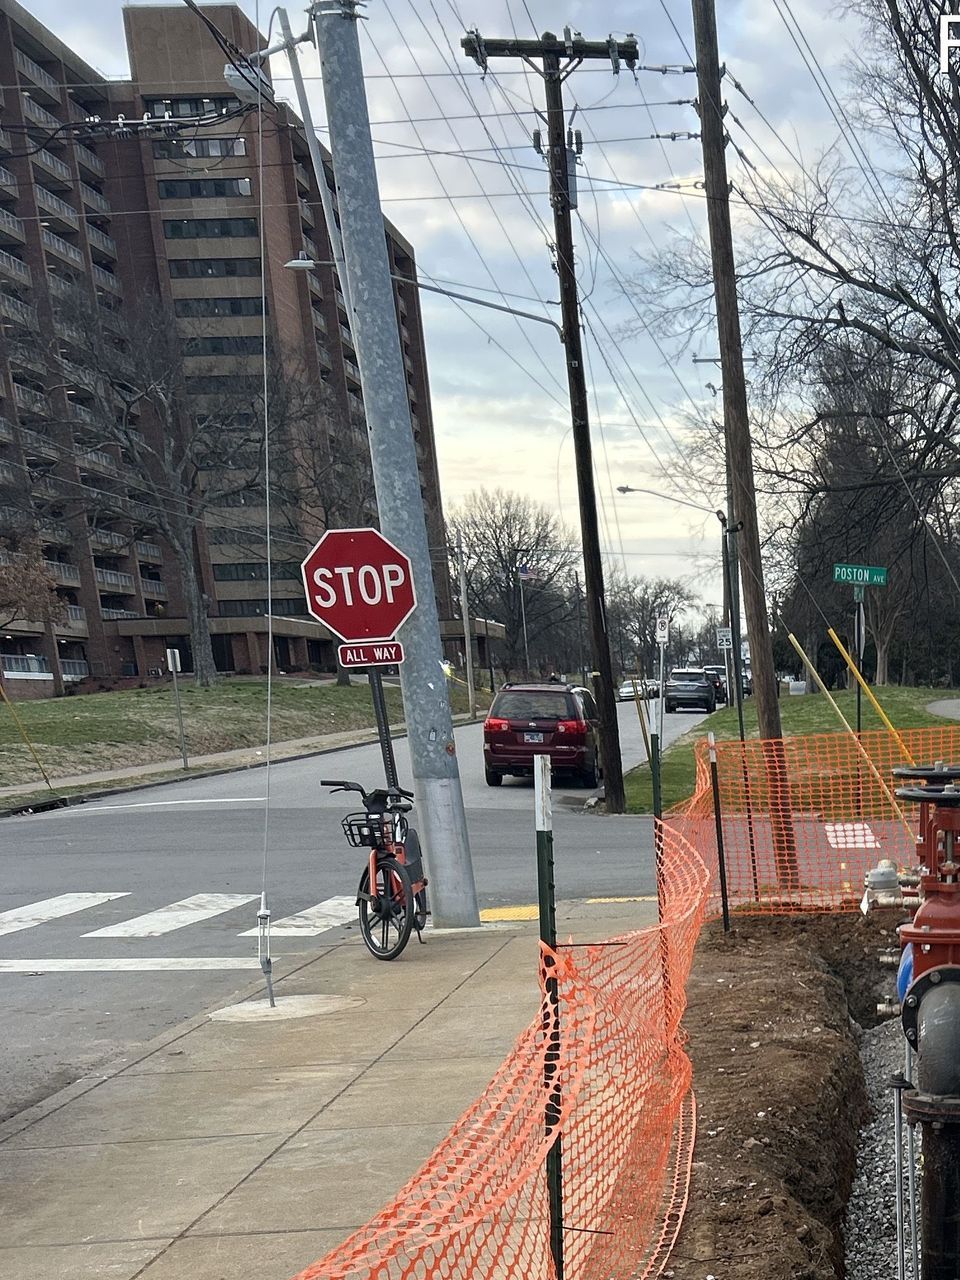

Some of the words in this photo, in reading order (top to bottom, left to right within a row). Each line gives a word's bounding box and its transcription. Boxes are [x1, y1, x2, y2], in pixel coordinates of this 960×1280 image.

[834, 567, 870, 582] POSTON
[873, 575, 884, 583] AVE
[313, 564, 405, 609] STOP
[718, 638, 732, 647] 25
[346, 649, 368, 662] ALL
[373, 647, 396, 660] WAY
